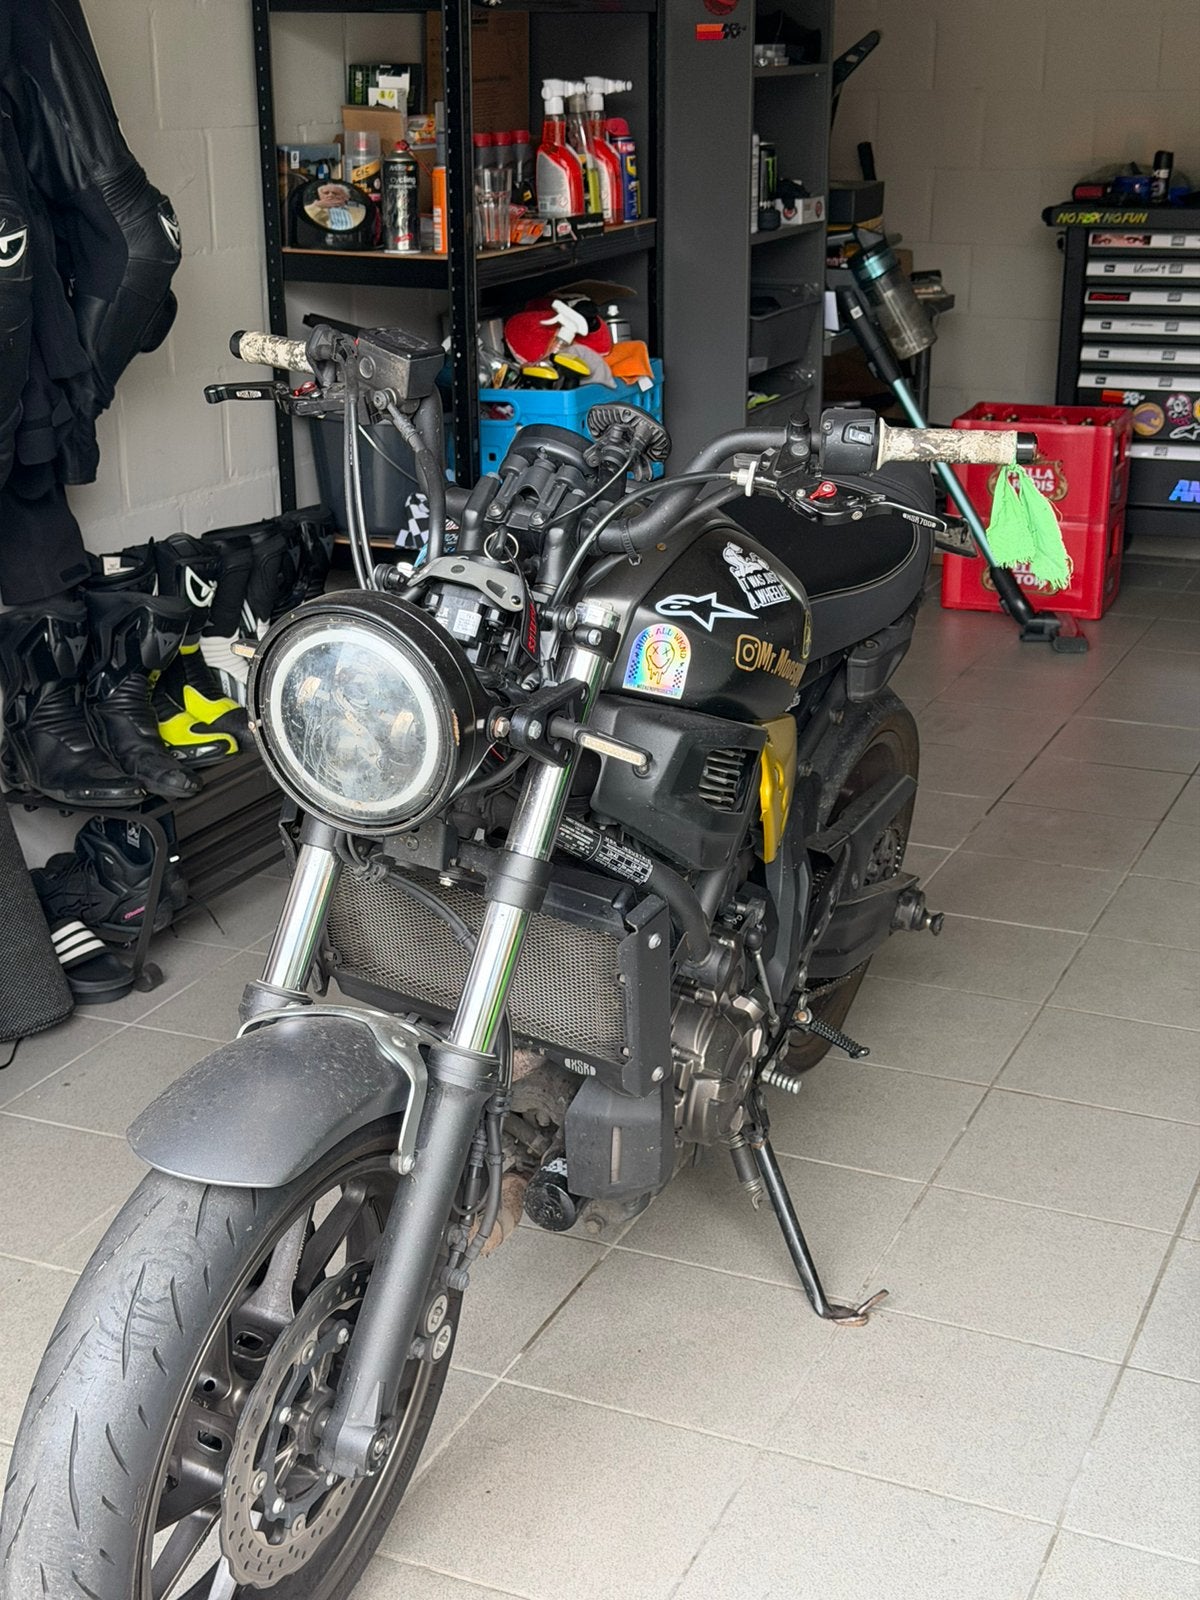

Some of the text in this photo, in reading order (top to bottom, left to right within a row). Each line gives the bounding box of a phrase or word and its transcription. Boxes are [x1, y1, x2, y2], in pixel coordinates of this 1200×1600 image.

[751, 574, 766, 588] WAS
[757, 586, 790, 605] WHEELIE
[636, 626, 688, 661] RIDE ALL WKND
